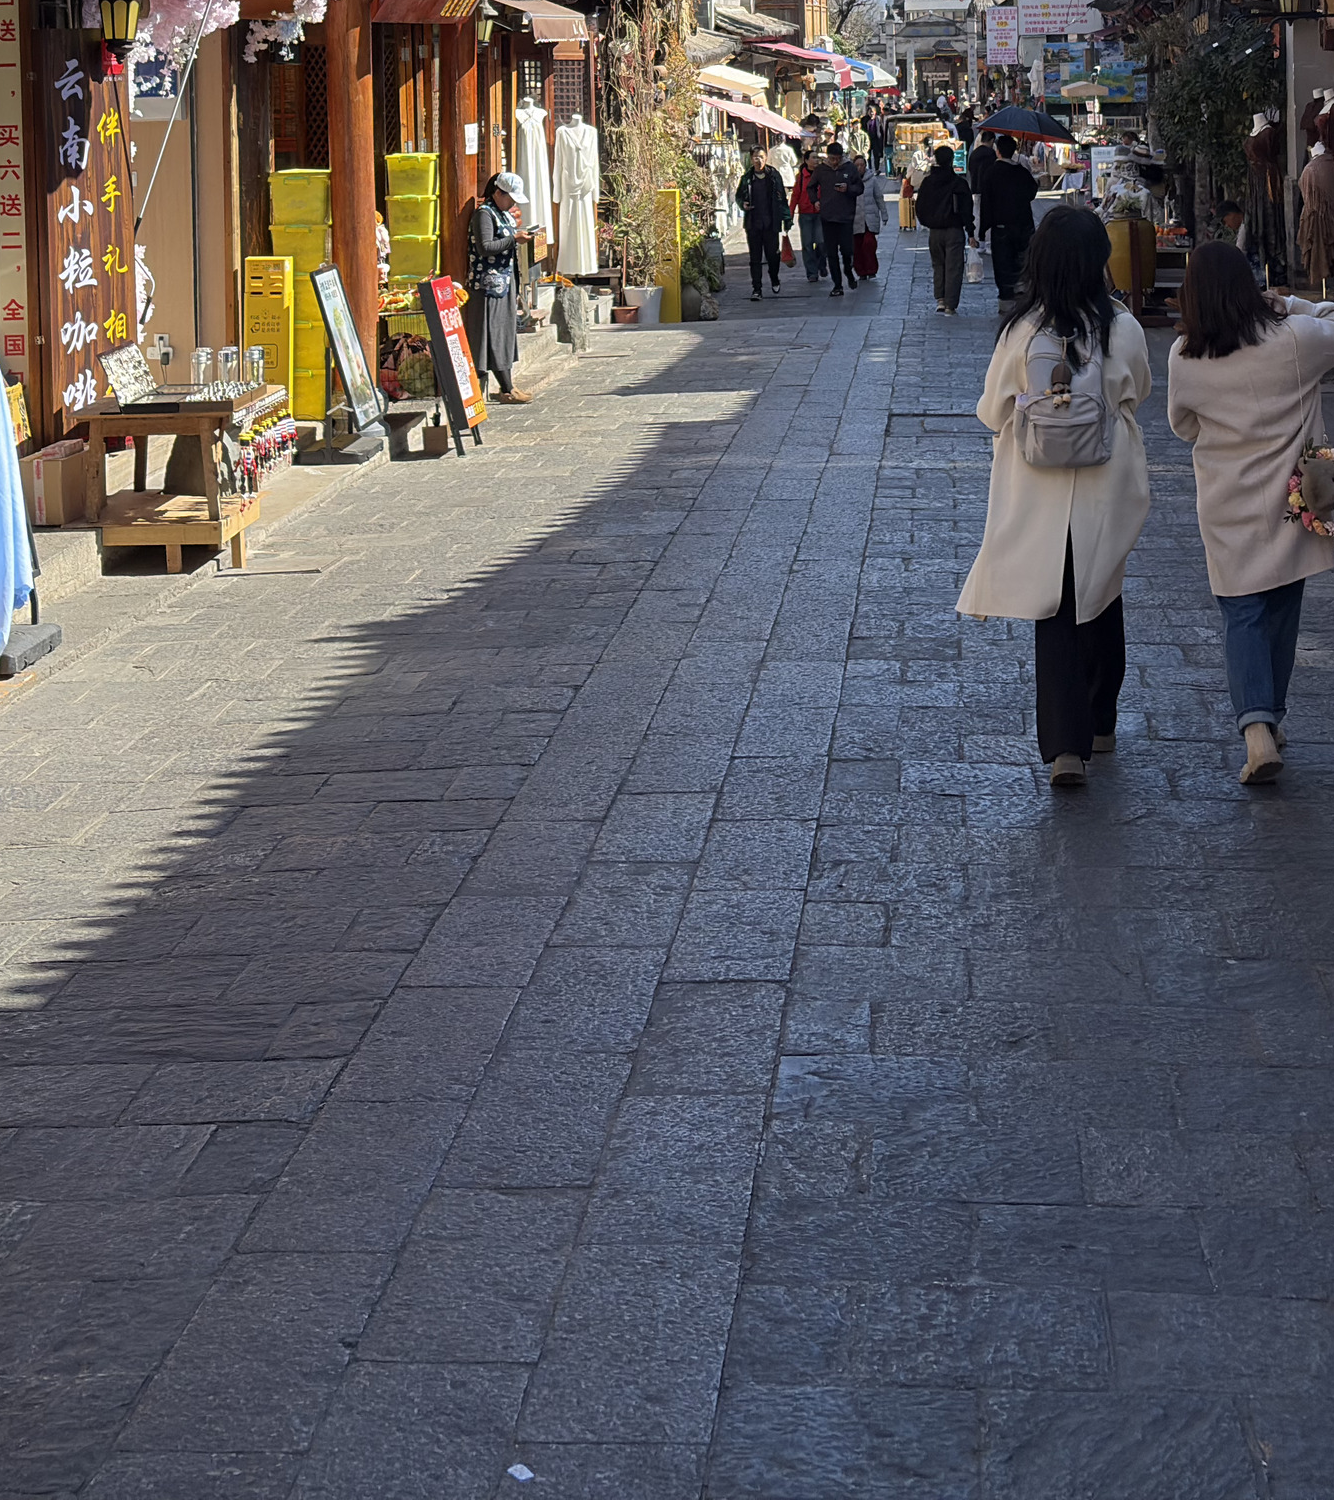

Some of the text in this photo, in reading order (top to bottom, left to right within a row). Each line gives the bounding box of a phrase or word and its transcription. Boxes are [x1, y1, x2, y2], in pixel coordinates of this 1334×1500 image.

[54, 58, 98, 412] 云南小粒咖啡
[97, 108, 128, 395] 伴手礼相
